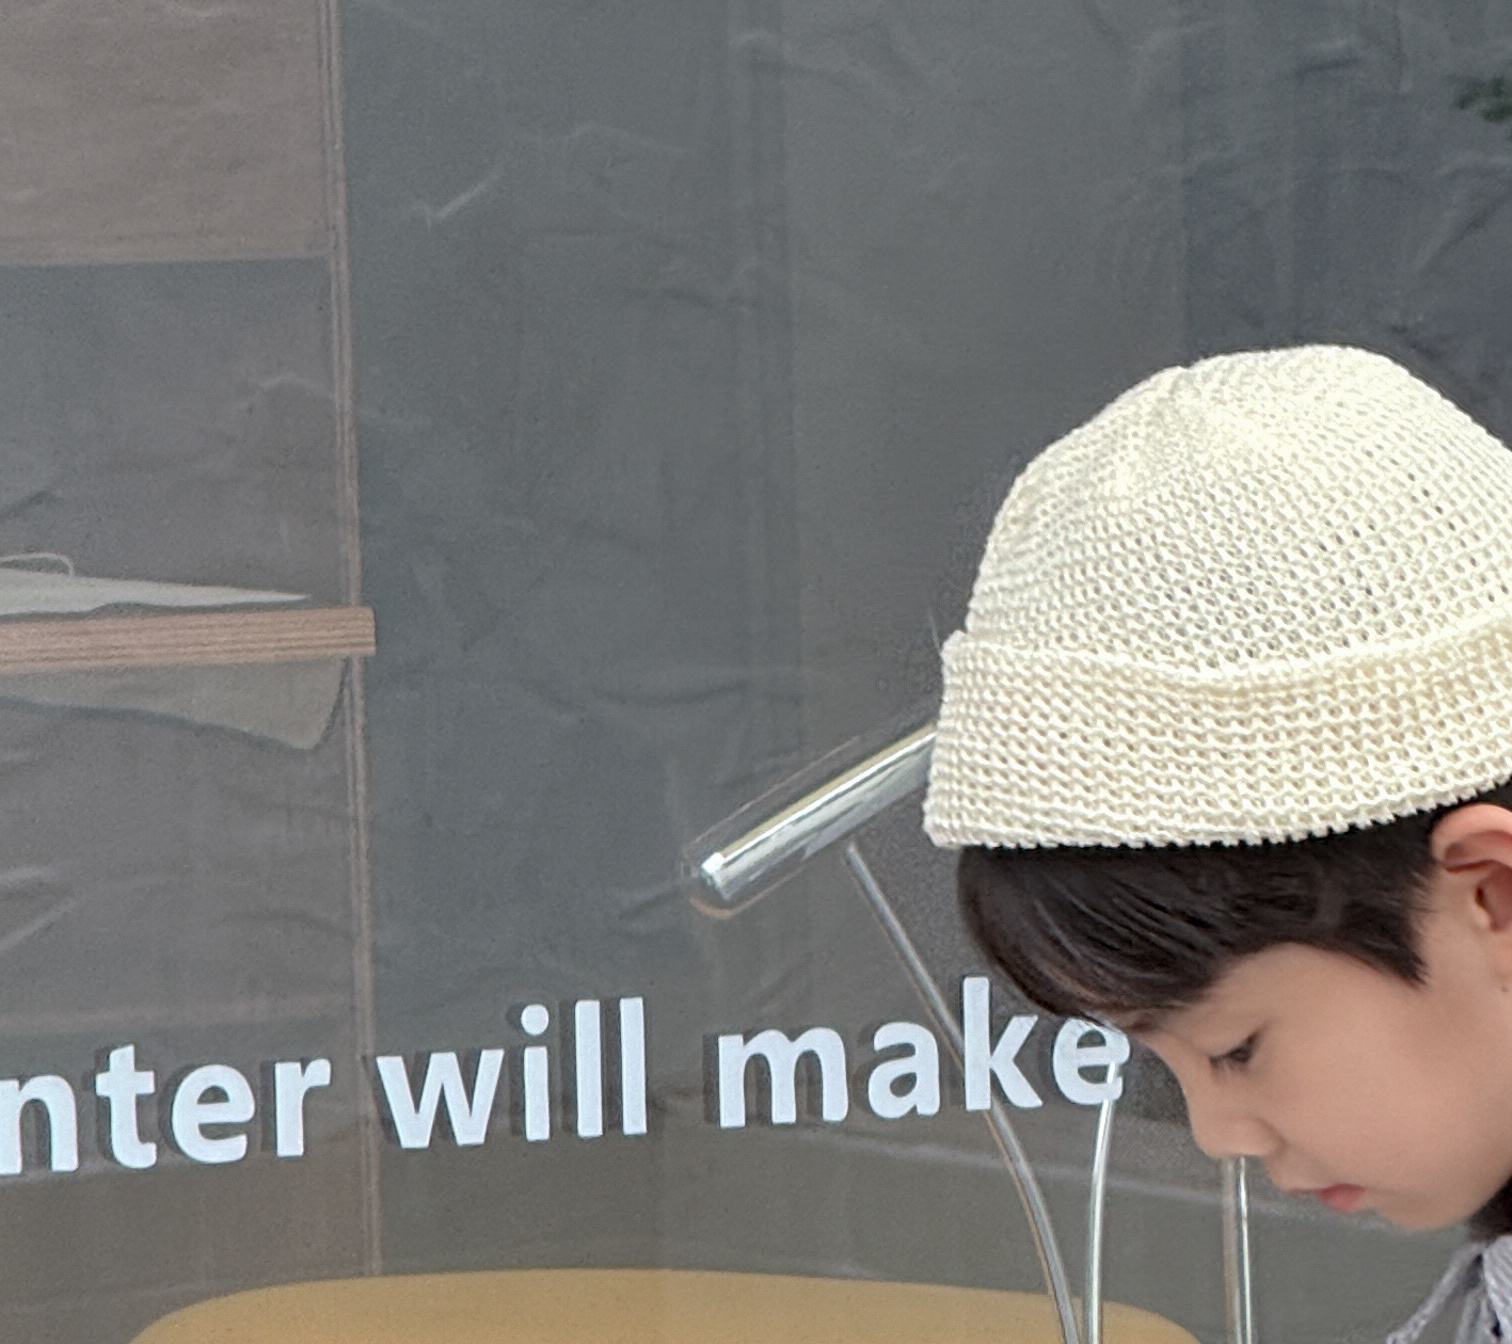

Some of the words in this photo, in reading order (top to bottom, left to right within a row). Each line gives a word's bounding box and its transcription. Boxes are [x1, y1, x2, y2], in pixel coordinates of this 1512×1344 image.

[0, 1044, 331, 1175] nter
[377, 997, 647, 1149] will
[718, 976, 1131, 1129] make
